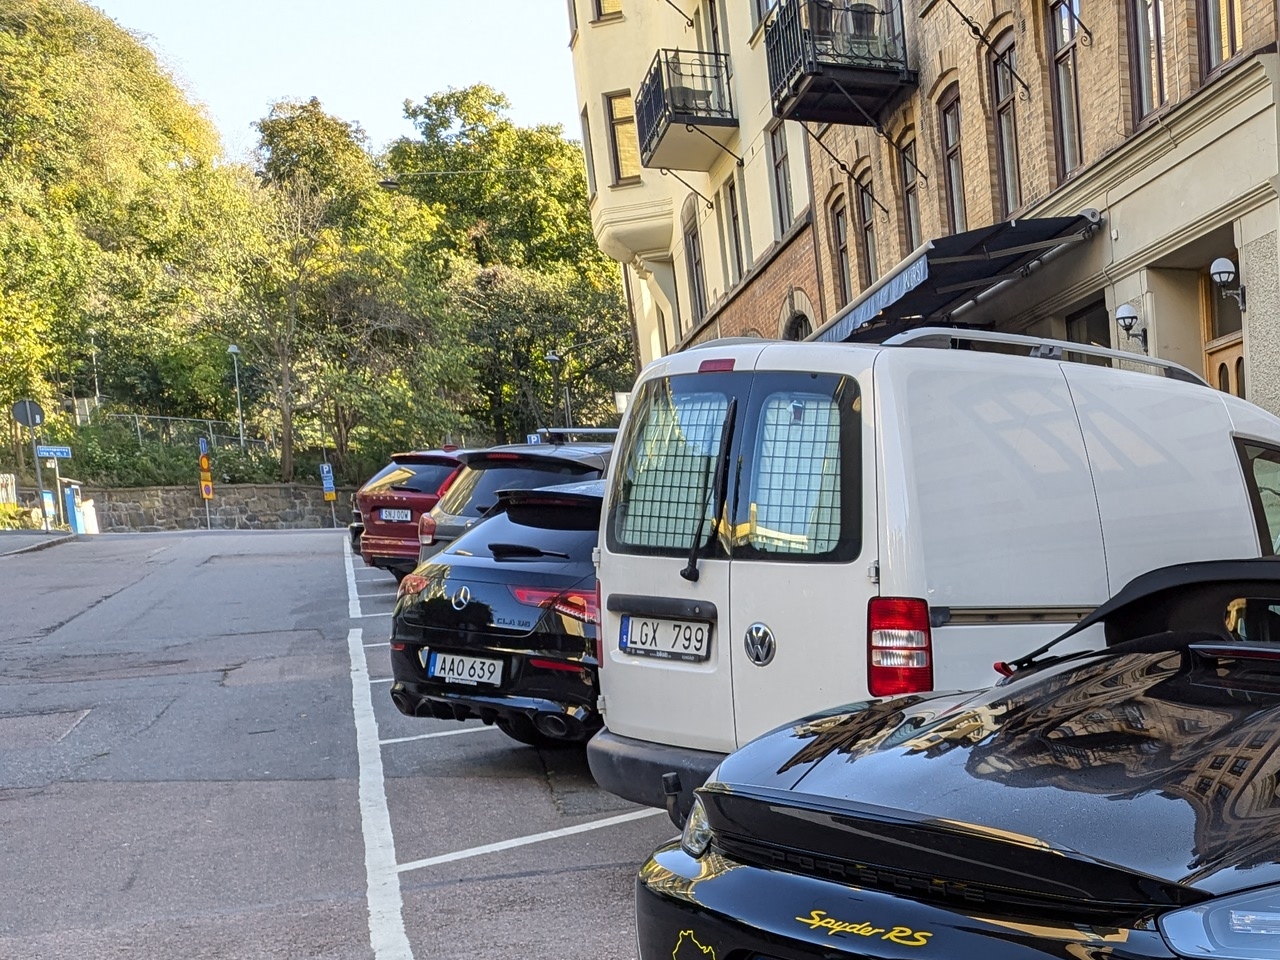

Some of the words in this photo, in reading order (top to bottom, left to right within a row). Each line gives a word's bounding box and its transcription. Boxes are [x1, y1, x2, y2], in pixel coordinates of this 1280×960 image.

[629, 620, 660, 648] LGX
[671, 624, 704, 652] 799
[439, 656, 465, 677] AAO
[468, 660, 497, 681] 639
[771, 852, 985, 903] PORSCHE
[795, 910, 885, 935] Spyder
[881, 926, 933, 946] RS
